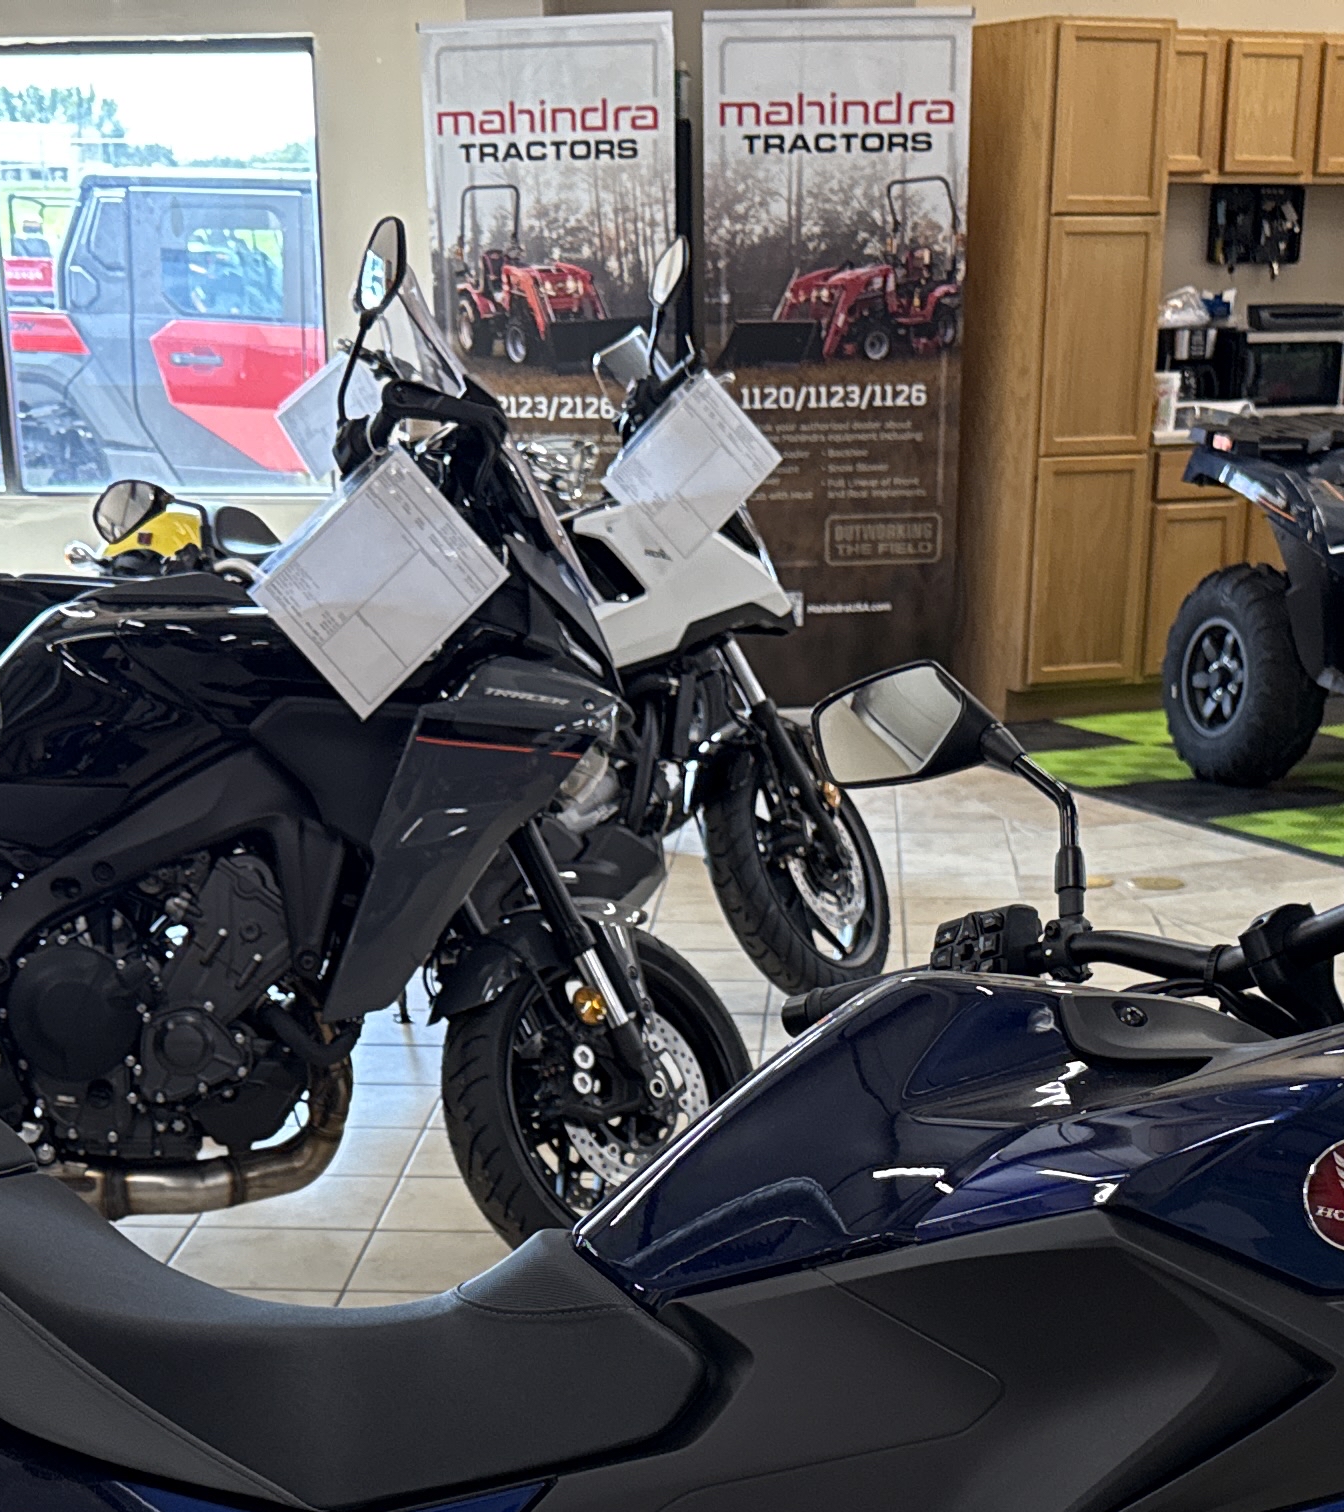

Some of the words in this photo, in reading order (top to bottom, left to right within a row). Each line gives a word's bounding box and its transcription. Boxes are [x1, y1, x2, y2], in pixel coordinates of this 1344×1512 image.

[436, 97, 659, 136] mahindra
[719, 91, 955, 126] mahindra
[459, 139, 638, 163] TRACTORS
[742, 132, 933, 154] TRACTORS
[740, 383, 928, 412] 1120/1123/1126
[835, 543, 873, 556] THE
[877, 541, 933, 555] FIELD
